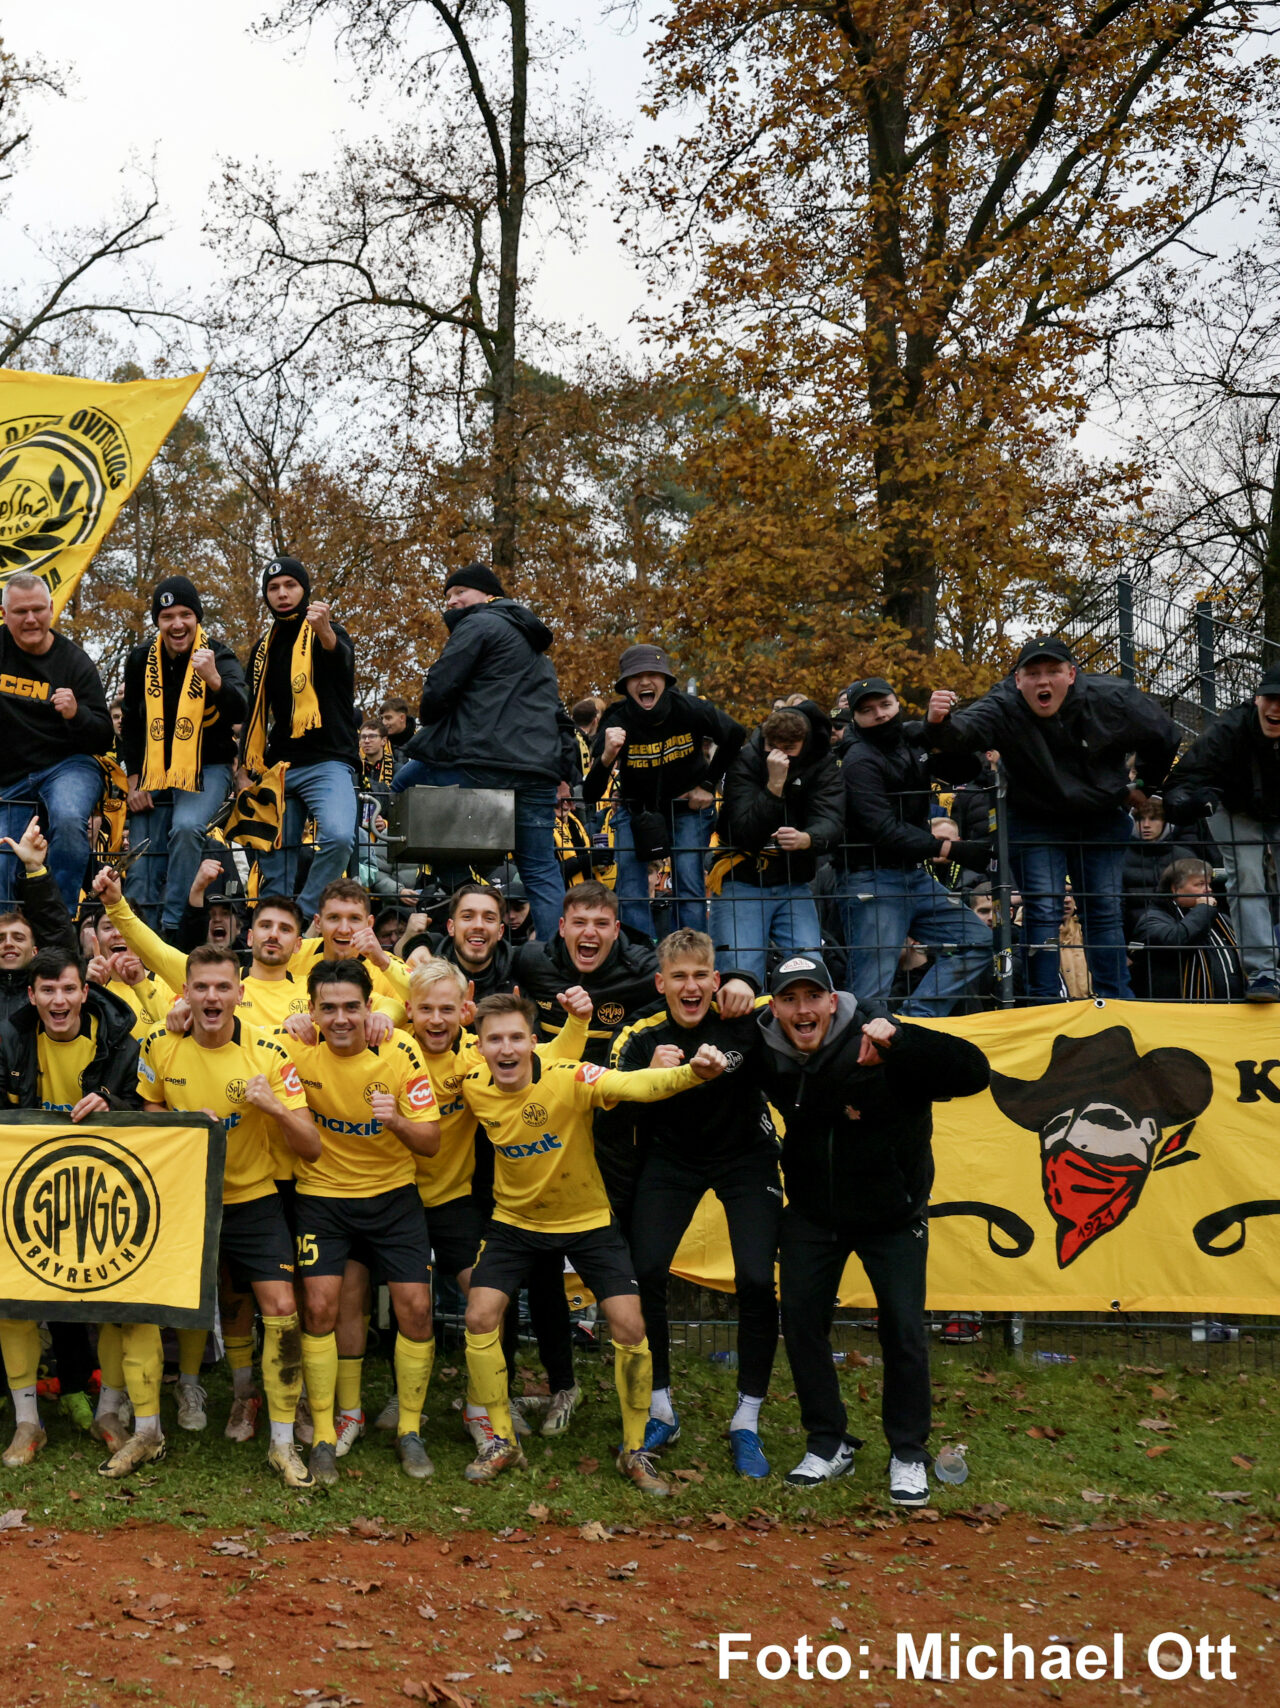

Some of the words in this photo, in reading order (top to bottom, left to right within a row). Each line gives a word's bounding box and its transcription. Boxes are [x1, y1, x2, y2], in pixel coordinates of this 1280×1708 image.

[439, 1097, 464, 1116] xit
[33, 1166, 131, 1264] SPVGG
[1077, 1208, 1116, 1239] 1921
[25, 1244, 137, 1283] BAYREUTH
